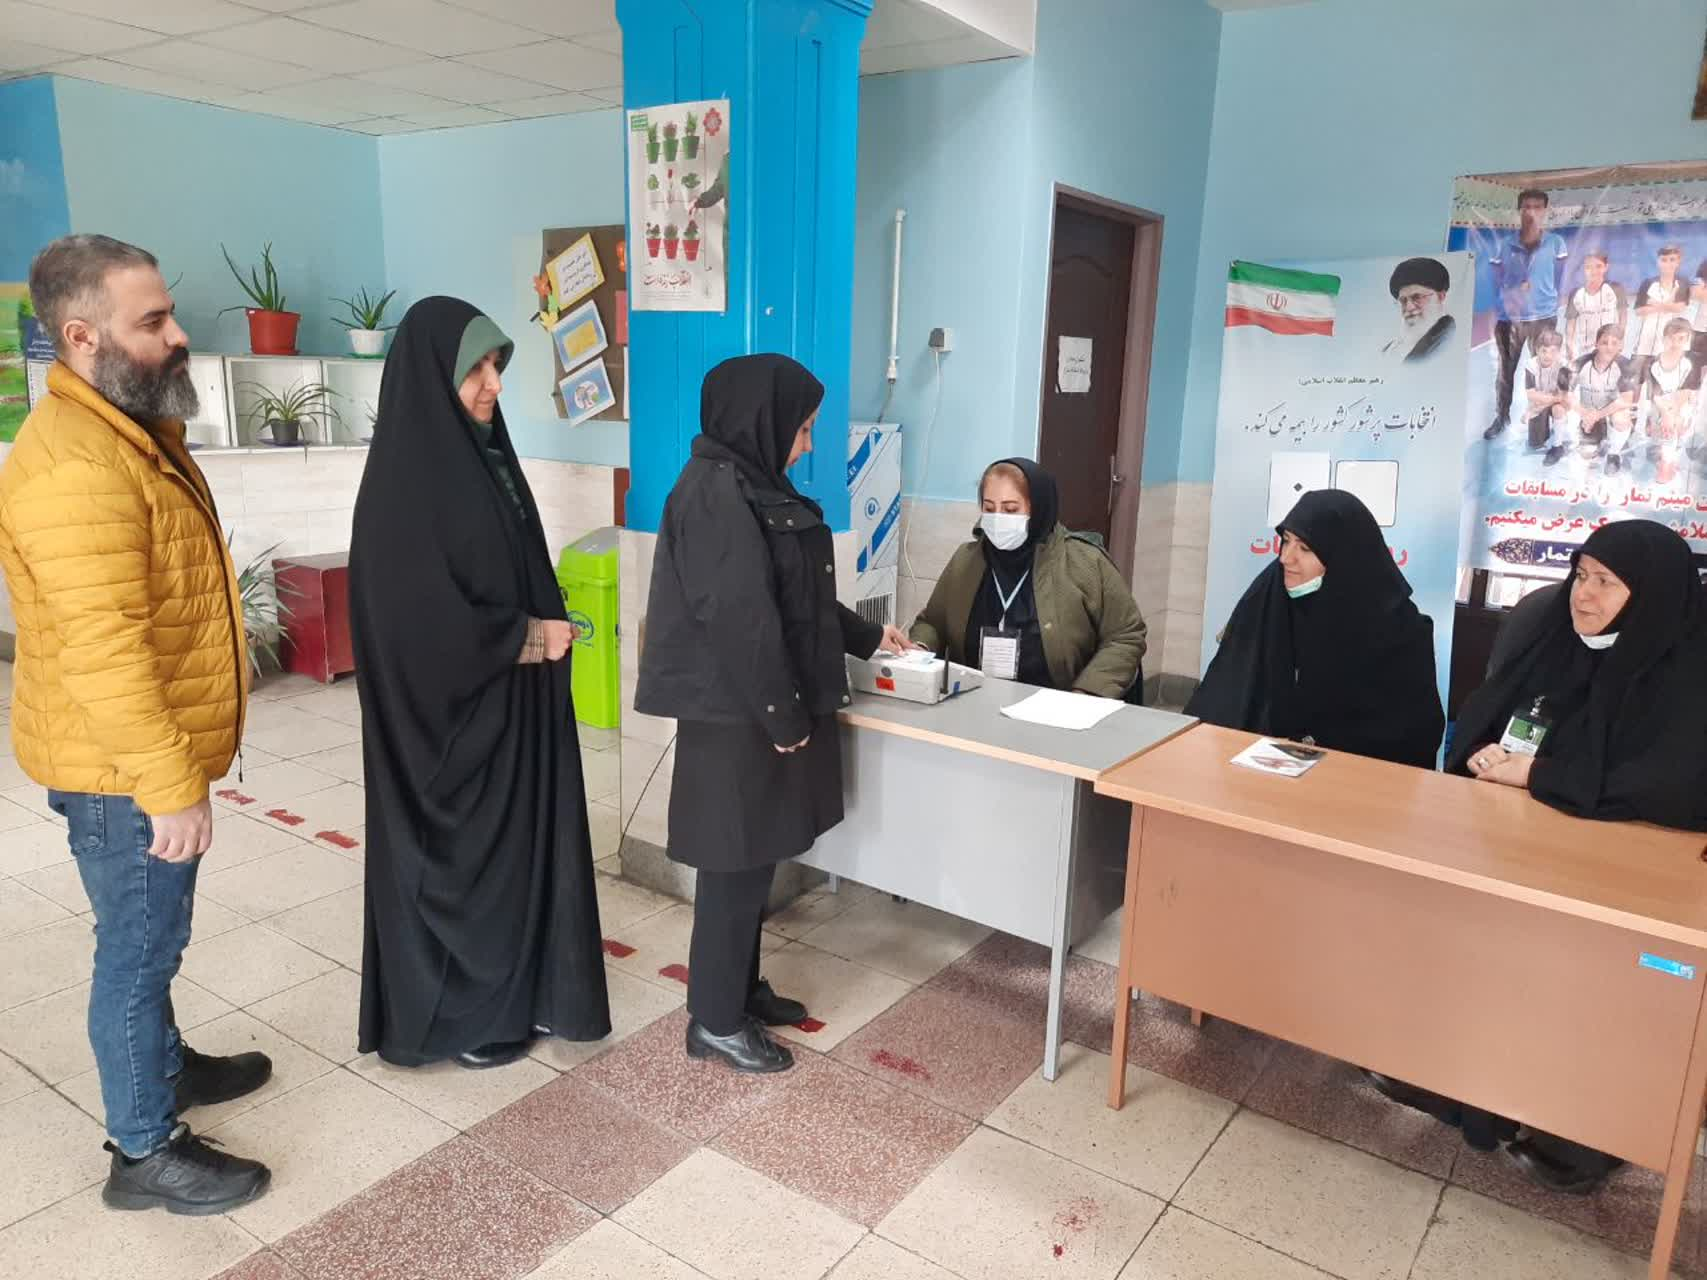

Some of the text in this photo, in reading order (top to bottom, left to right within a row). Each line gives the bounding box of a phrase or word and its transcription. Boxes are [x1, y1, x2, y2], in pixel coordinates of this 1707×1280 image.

[1384, 406, 1436, 439] انتخابات
[1505, 480, 1566, 499] مسابقات
[1542, 512, 1584, 532] عرض
